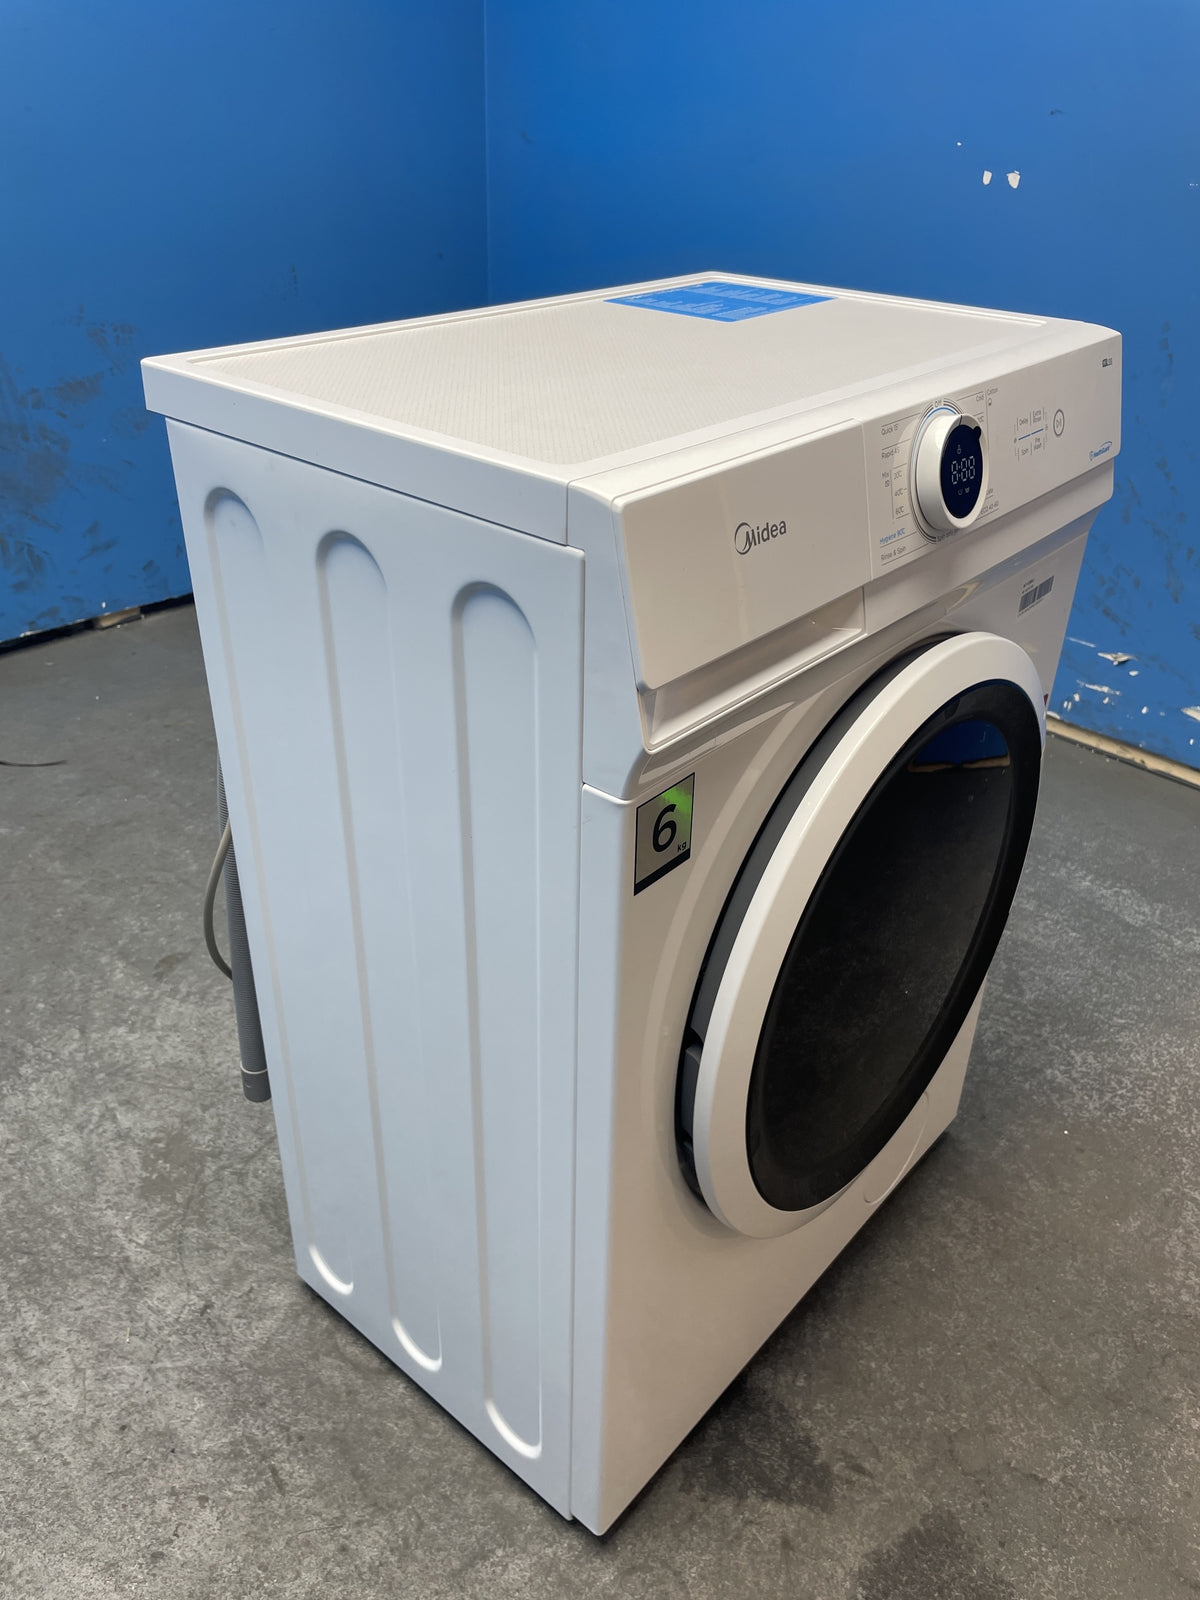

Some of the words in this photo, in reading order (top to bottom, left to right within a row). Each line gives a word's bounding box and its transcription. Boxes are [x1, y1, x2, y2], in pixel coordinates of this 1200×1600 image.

[734, 520, 787, 555] Midea
[652, 803, 677, 853] 6
[677, 841, 687, 852] kg
